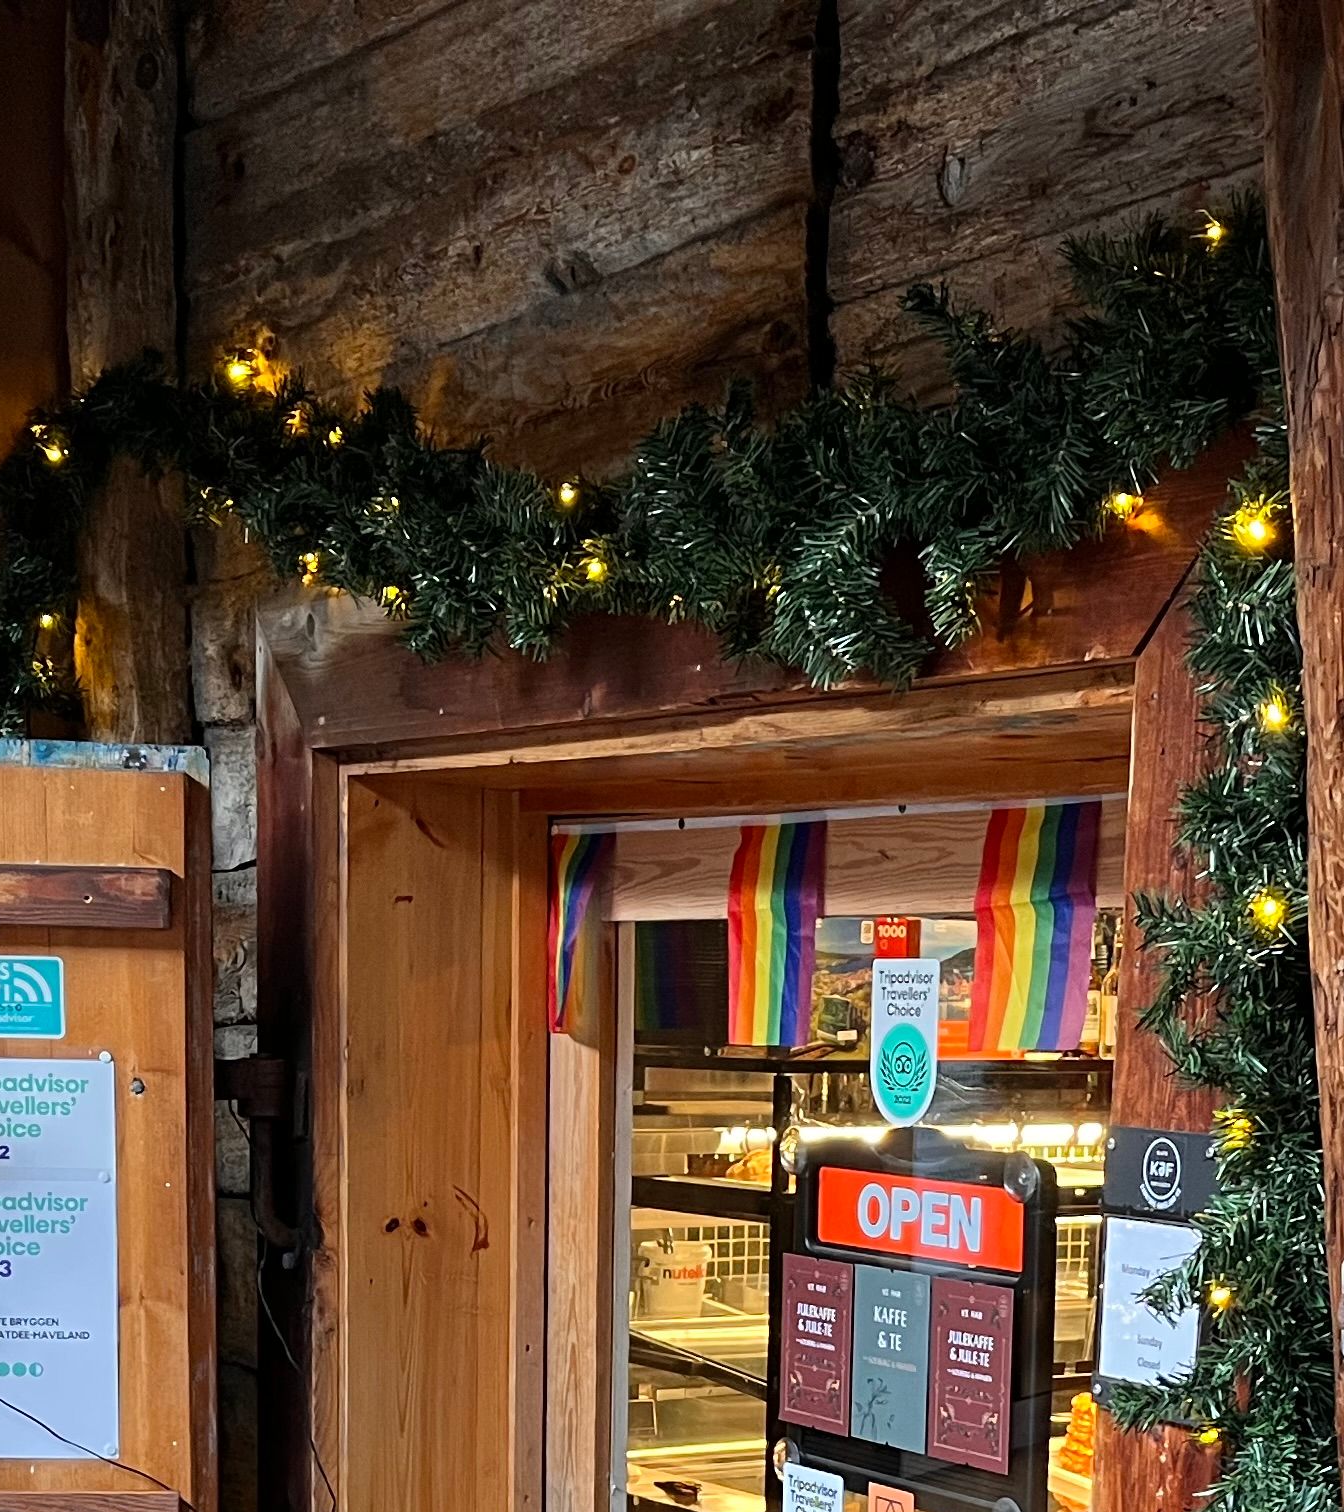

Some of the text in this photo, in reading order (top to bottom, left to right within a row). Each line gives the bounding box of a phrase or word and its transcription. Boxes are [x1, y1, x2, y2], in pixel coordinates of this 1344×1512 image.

[877, 924, 907, 938] 1000
[879, 969, 934, 987] Tripadvisor
[886, 1002, 922, 1018] Choice
[857, 1183, 982, 1253] OPEN
[797, 1302, 836, 1323] JULEKAFFE
[873, 1305, 908, 1328] KAFFE
[9, 1317, 60, 1328] BRYGGEN
[877, 1330, 903, 1352] & TE
[947, 1329, 994, 1352] JULEKAFFE
[1136, 1334, 1163, 1350] Sunday
[1136, 1356, 1161, 1371] Closed
[787, 1473, 838, 1499] Tripadvisor
